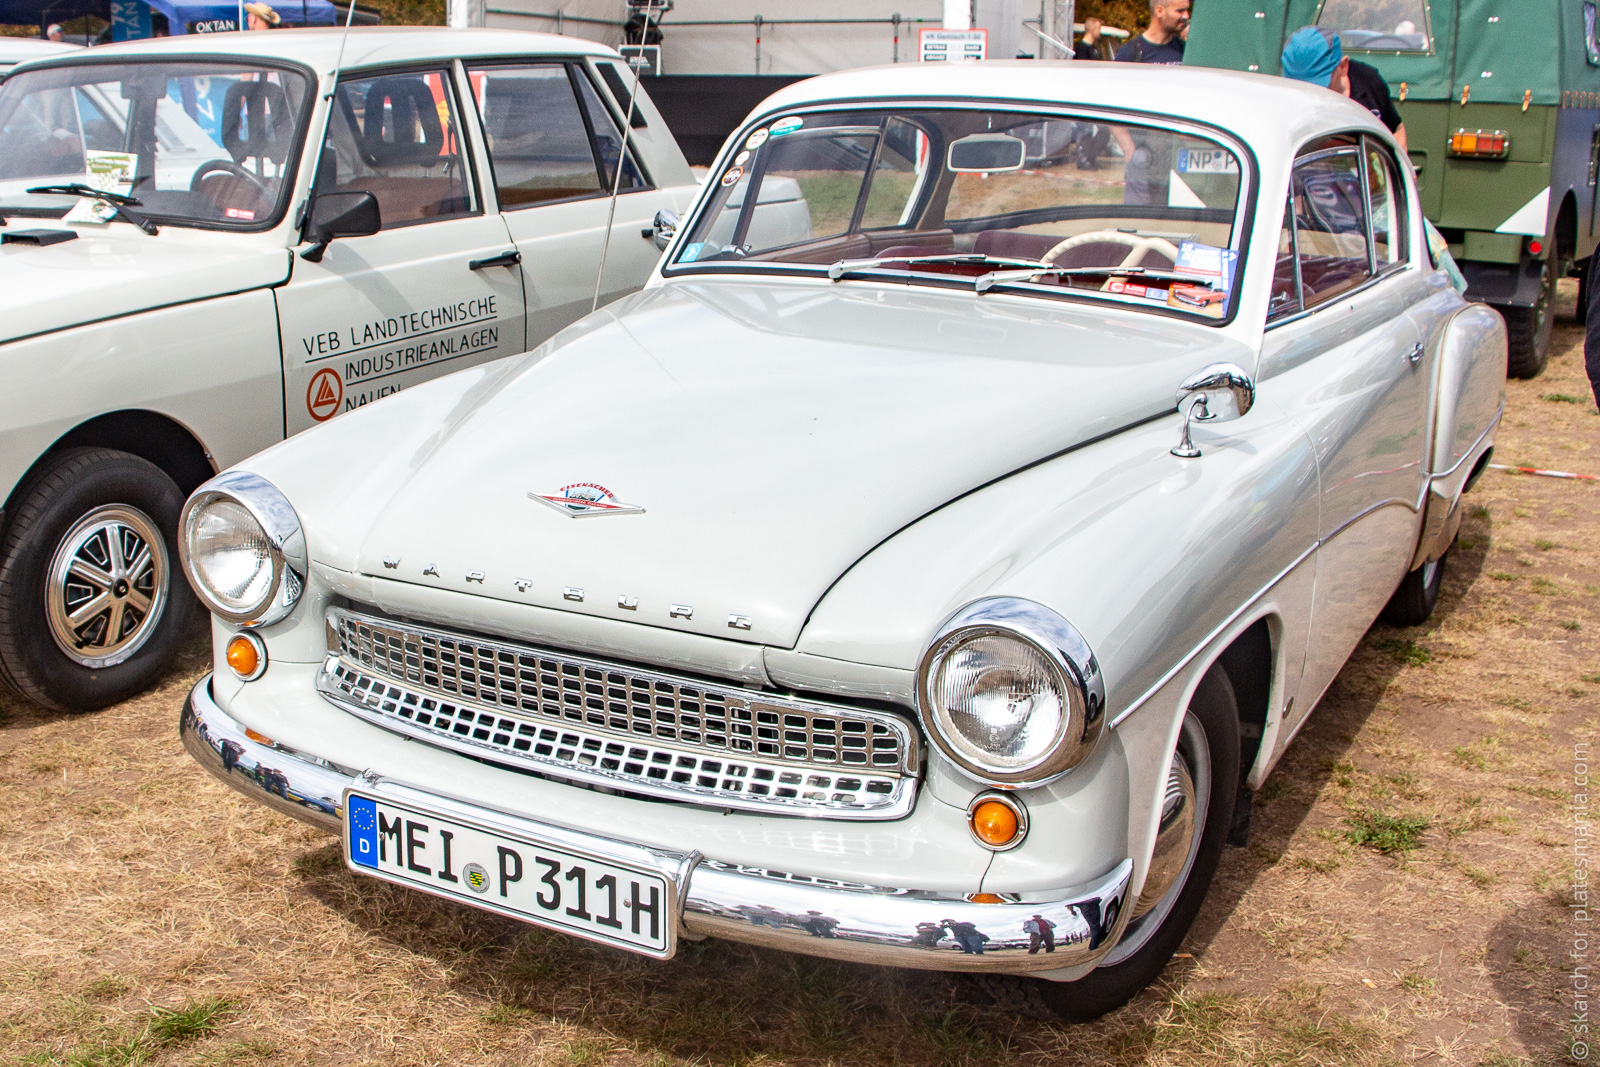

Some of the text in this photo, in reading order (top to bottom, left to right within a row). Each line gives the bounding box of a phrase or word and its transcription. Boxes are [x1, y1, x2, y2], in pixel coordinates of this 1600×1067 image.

[196, 20, 235, 33] OKTAN
[1189, 151, 1212, 169] NP
[1224, 152, 1236, 169] P
[303, 295, 498, 356] VEB LANDTECHNISCHE
[345, 327, 499, 380] INDUSTRIEANLAGEN
[560, 482, 614, 499] EISENACHER
[382, 555, 753, 630] WARTBURG
[360, 838, 370, 854] D
[378, 811, 459, 884] MEI
[497, 845, 523, 897] P
[535, 856, 660, 940] 311H
